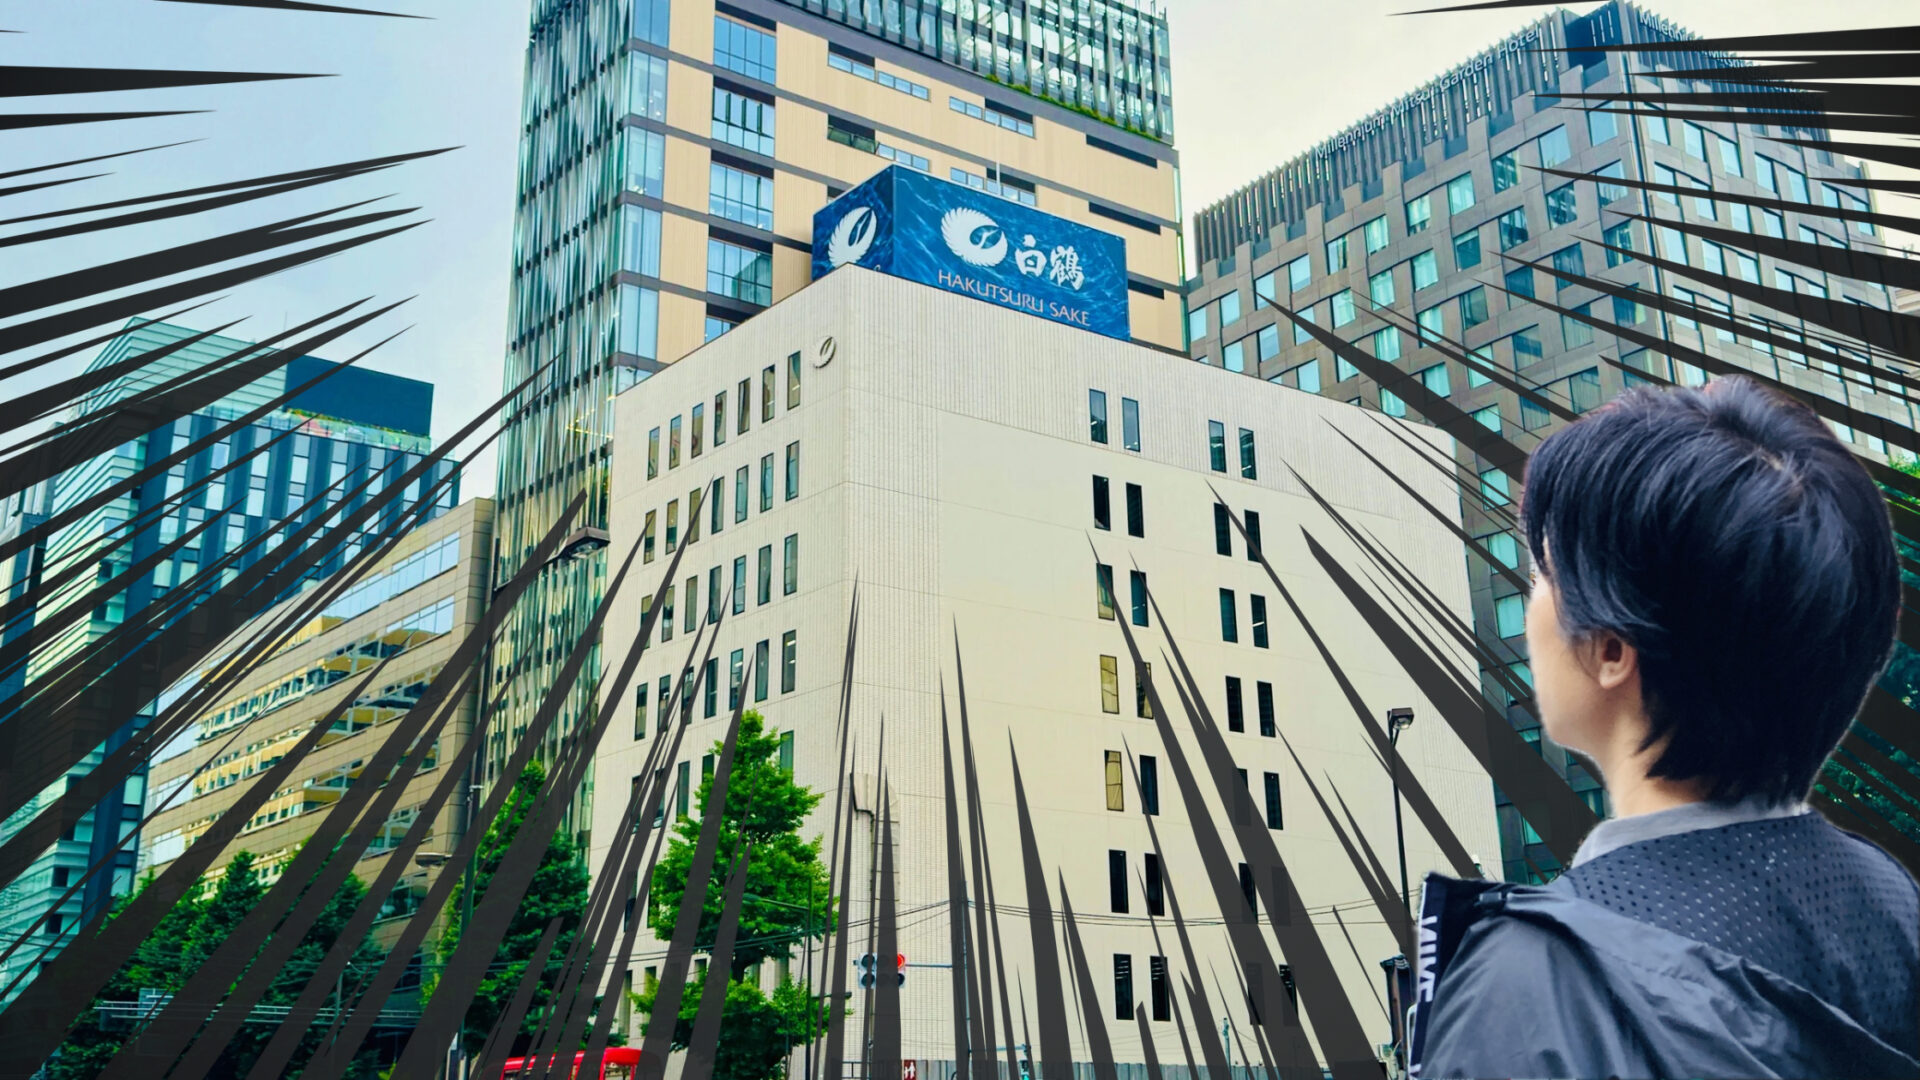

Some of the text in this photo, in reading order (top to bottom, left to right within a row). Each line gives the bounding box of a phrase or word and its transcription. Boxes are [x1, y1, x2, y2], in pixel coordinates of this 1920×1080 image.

[1315, 23, 1540, 159] Millennium Mitsui Garden Hotel
[1015, 234, 1085, 290] 白鶴
[938, 270, 1091, 327] HAKUTSURU SAKE
